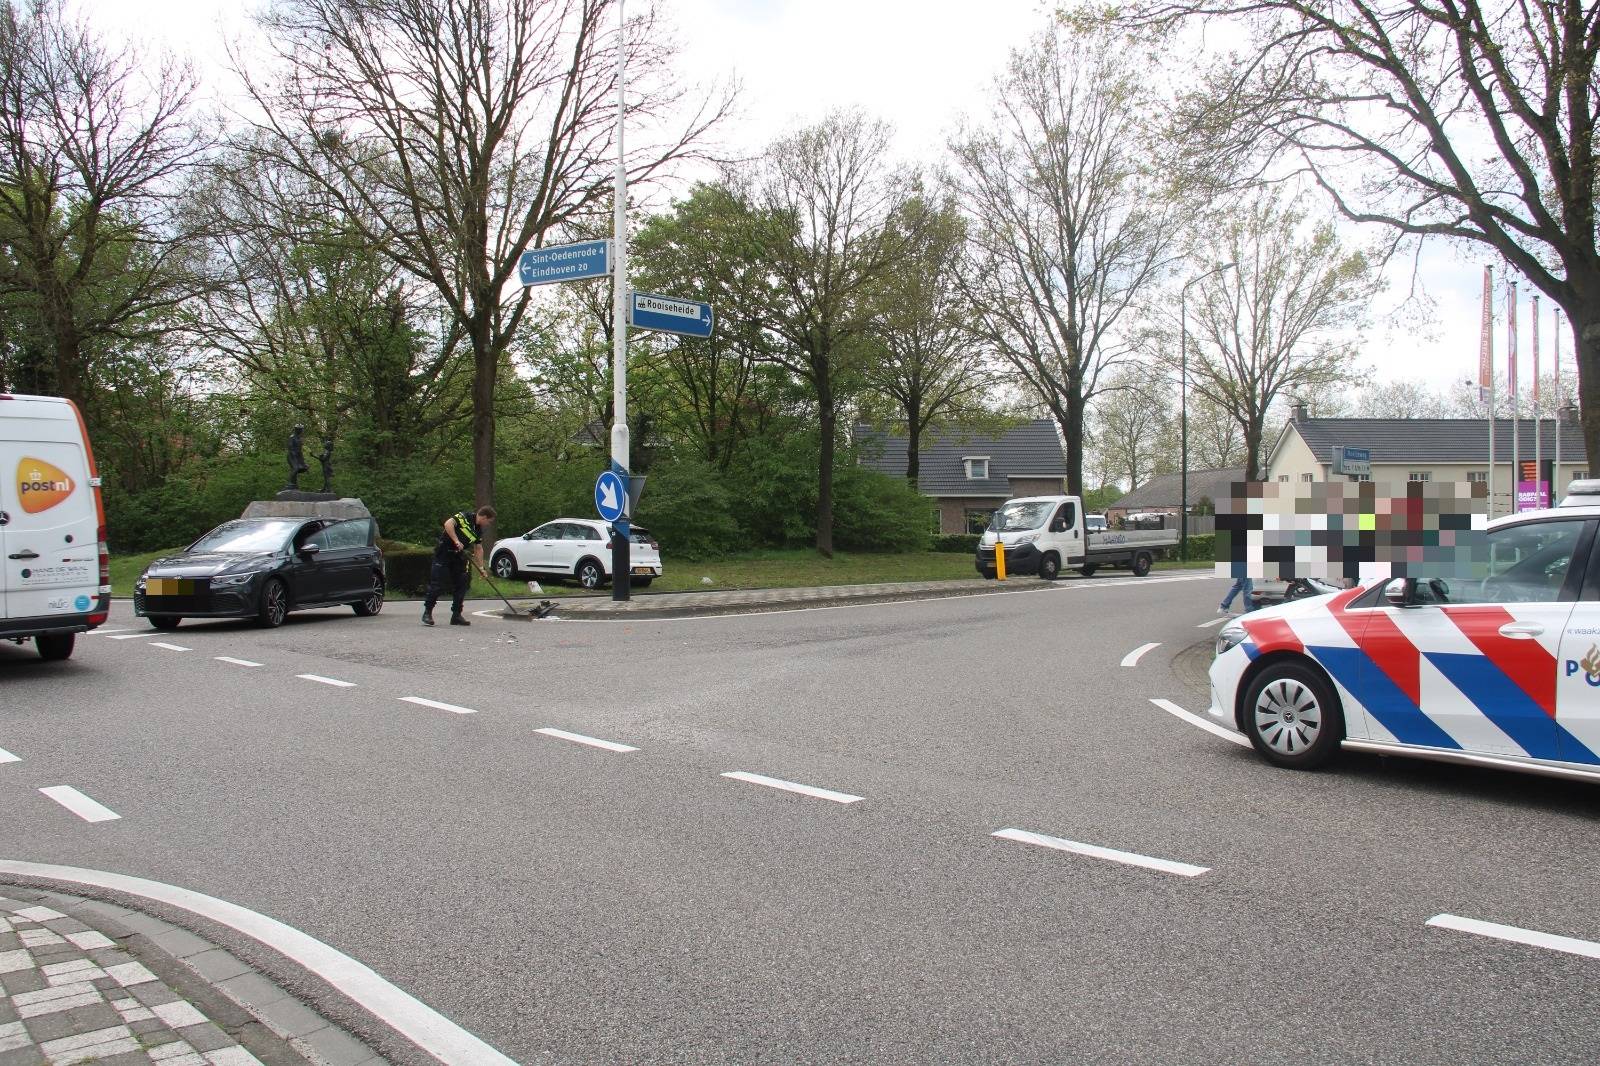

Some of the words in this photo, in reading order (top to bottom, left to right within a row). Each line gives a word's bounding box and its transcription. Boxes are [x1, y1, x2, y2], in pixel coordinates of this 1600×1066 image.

[532, 247, 597, 264] Sint-Oedenrode
[598, 246, 605, 255] 4
[532, 265, 576, 278] Eindhoven
[578, 263, 588, 271] 20
[647, 299, 695, 315] Rooiseheide
[21, 477, 70, 495] postnl
